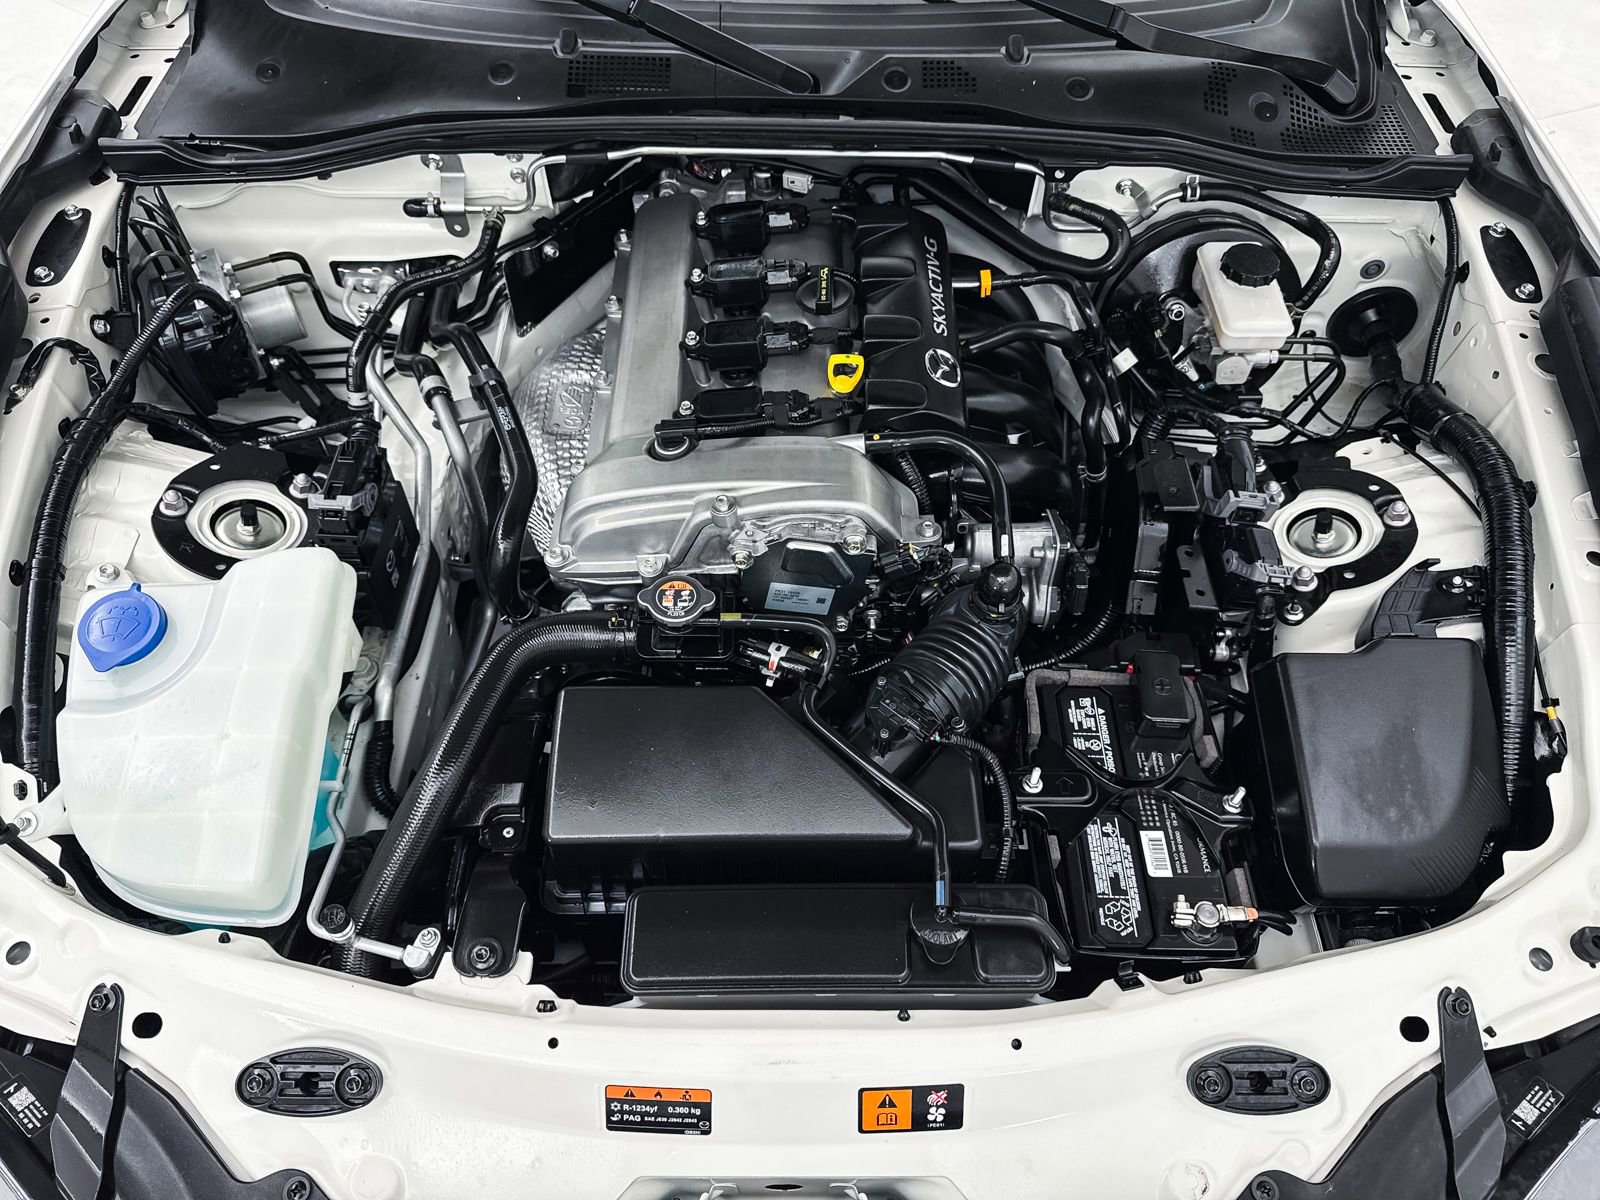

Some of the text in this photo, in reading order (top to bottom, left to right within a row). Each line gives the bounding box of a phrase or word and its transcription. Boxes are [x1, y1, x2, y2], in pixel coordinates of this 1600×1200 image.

[924, 236, 948, 337] SKYACTIV-G
[1099, 716, 1110, 744] DANGER
[623, 1104, 701, 1115] R-1234yf 0.360 kg
